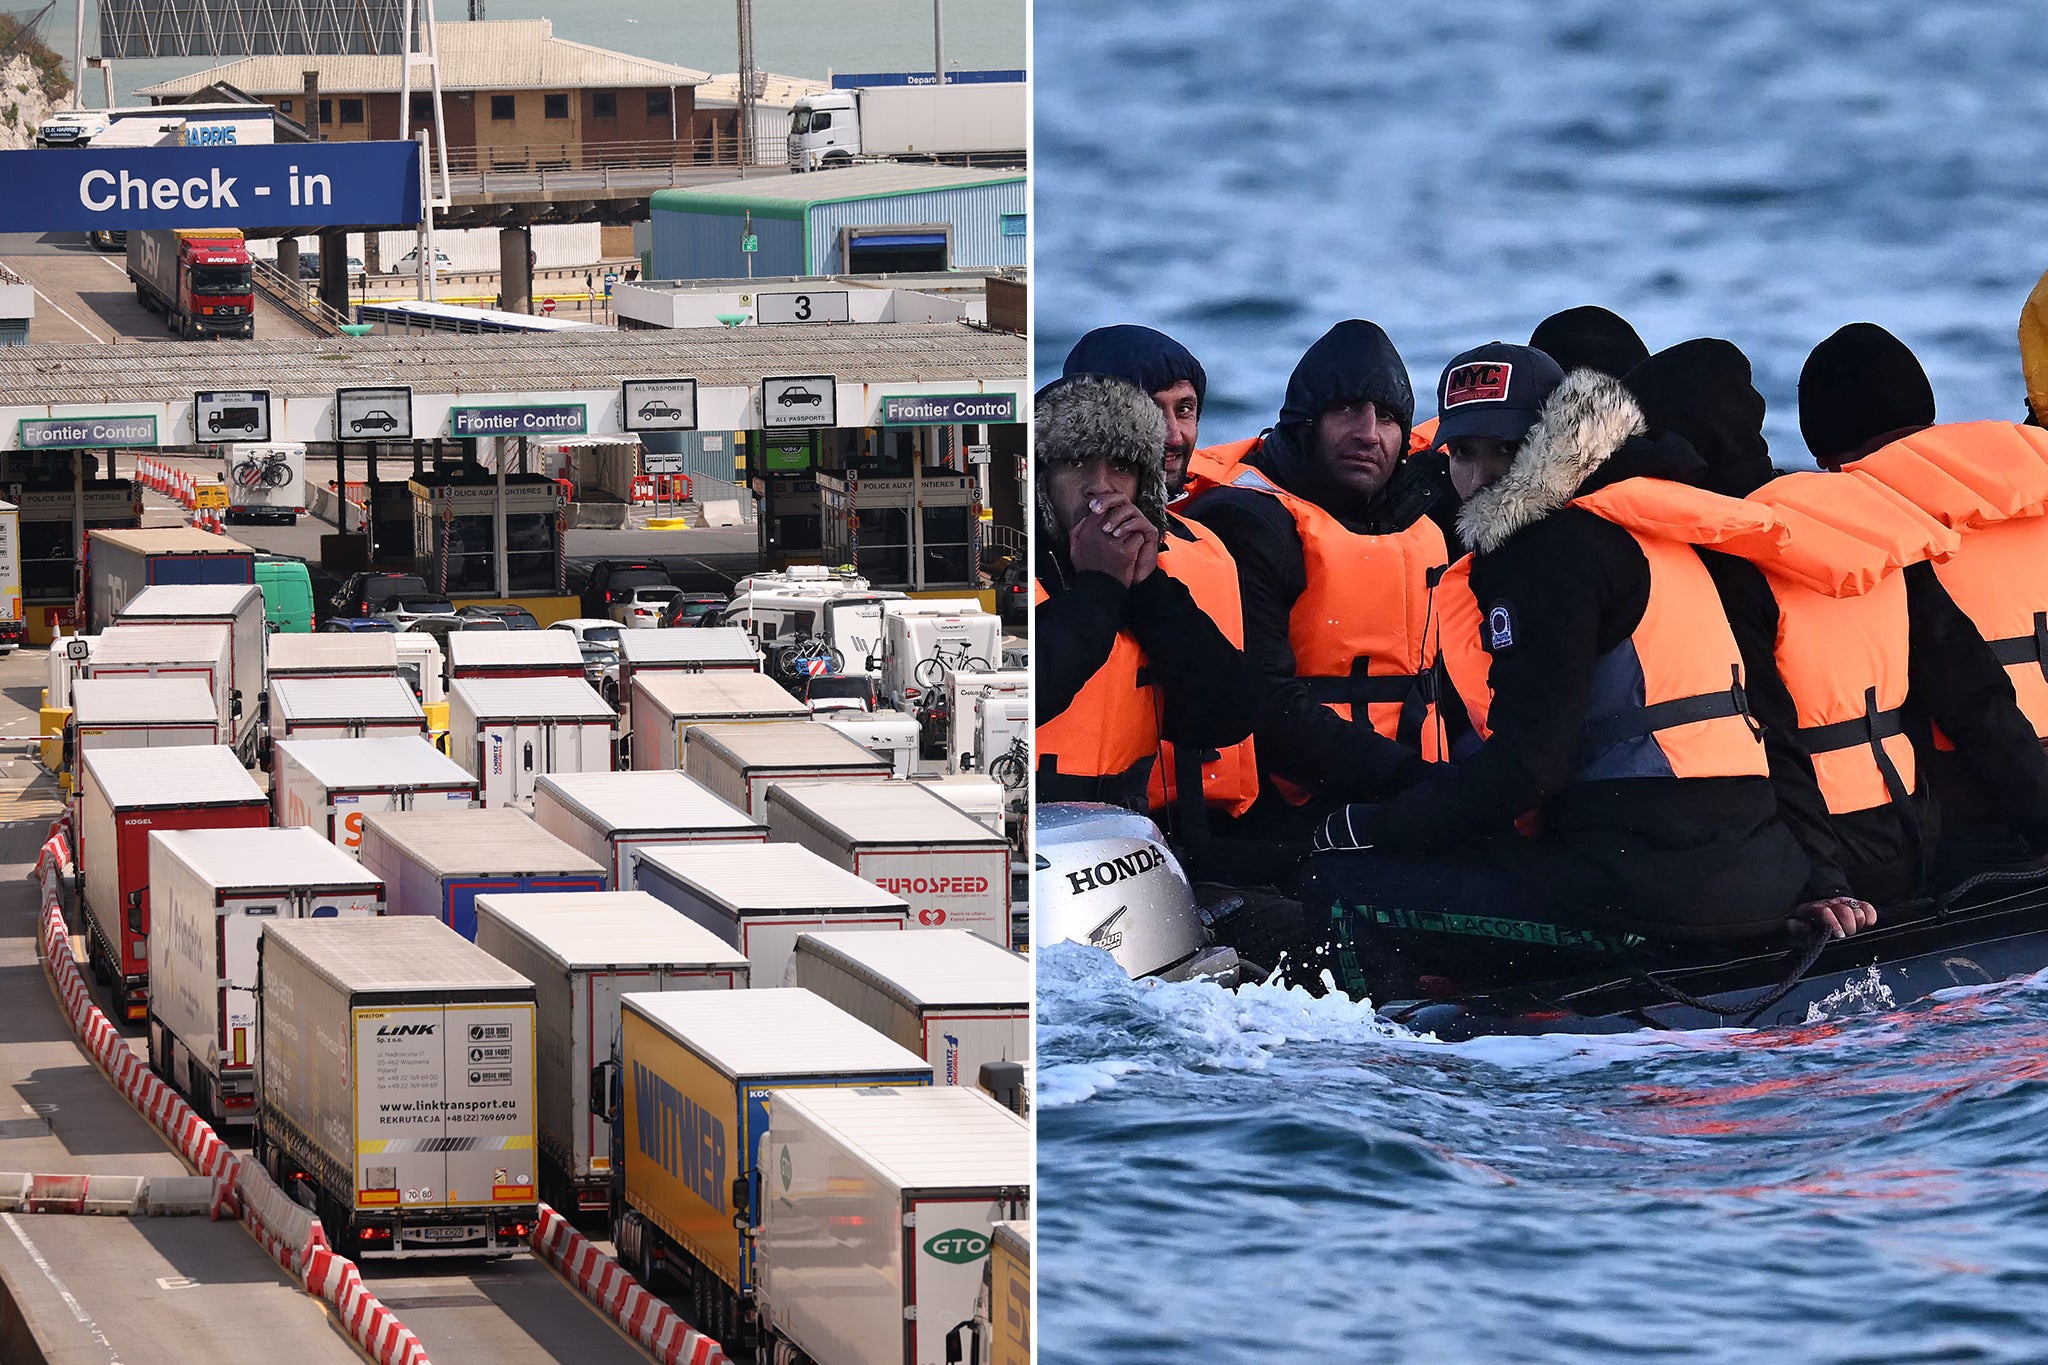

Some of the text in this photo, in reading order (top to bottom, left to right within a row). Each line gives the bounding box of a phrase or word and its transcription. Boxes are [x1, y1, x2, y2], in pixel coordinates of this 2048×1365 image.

[908, 76, 953, 85] Departs
[79, 168, 240, 212] Check
[289, 165, 332, 206] in
[794, 295, 812, 320] 3
[1451, 365, 1502, 391] NYC
[888, 401, 1011, 418] Frontier Control
[457, 412, 582, 429] Frontier Control
[26, 425, 151, 442] Frontier Control
[849, 471, 856, 480] 5
[133, 484, 141, 493] 2
[863, 480, 955, 490] POLICE AUX FNTIERES
[12, 486, 19, 495] 1
[446, 487, 453, 496] 3
[454, 489, 476, 497] OLICE
[505, 488, 541, 496] ONTIERES
[973, 489, 981, 498] 6
[27, 495, 55, 503] POLICE
[83, 493, 121, 501] ONTIERES
[557, 497, 565, 506] 4
[1065, 844, 1167, 896] HONDA
[876, 876, 989, 894] EUROSPEED
[1449, 914, 1552, 943] LACOSTE
[485, 1027, 495, 1035] ISO
[380, 1100, 516, 1112] www.linktransport.eu
[380, 1113, 517, 1124] REKRUTACJA +48 (22) 769 69 09
[633, 1059, 727, 1217] WITTWER
[408, 1190, 418, 1199] 70
[421, 1190, 433, 1198] 80
[932, 1238, 986, 1254] GTO
